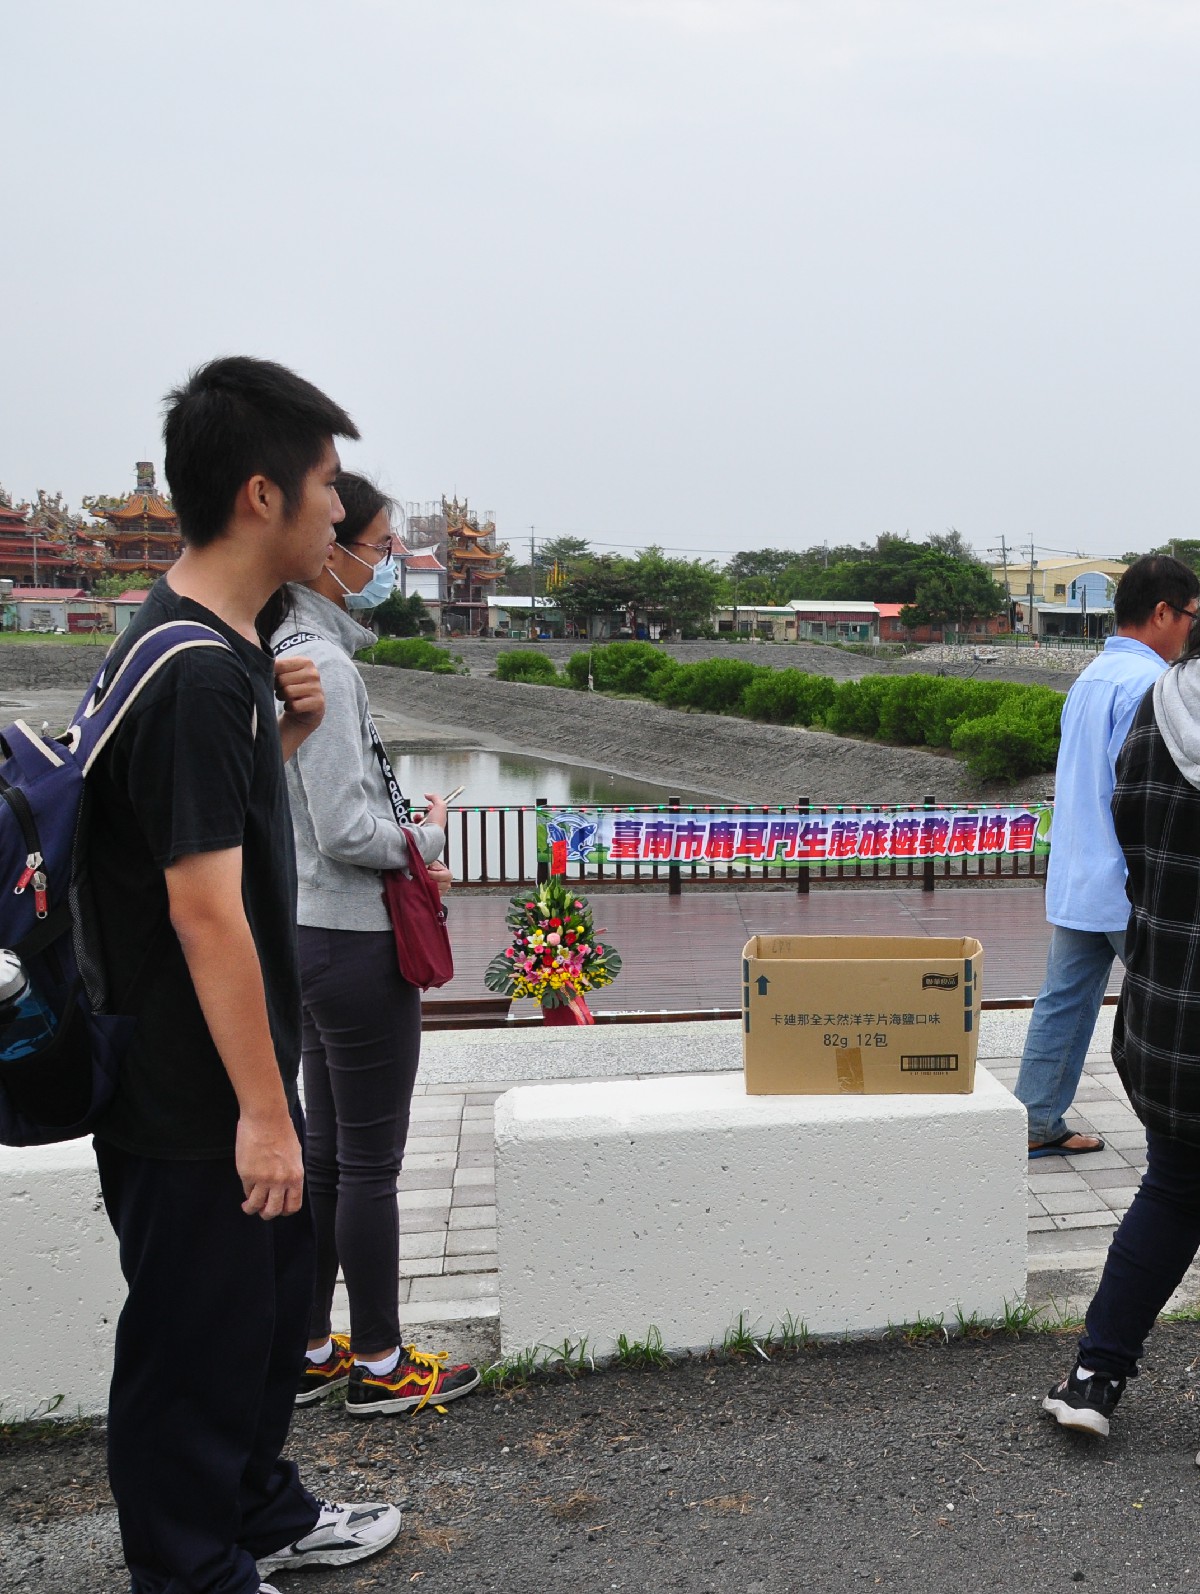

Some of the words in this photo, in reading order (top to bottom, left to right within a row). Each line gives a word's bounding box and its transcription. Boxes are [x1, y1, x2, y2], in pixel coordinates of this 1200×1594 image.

[280, 633, 321, 650] adid
[389, 780, 409, 827] adida
[608, 813, 1039, 861] 臺南市鹿耳門生態旅遊發展協會
[823, 1033, 848, 1048] 82g
[856, 1032, 888, 1048] 12包
